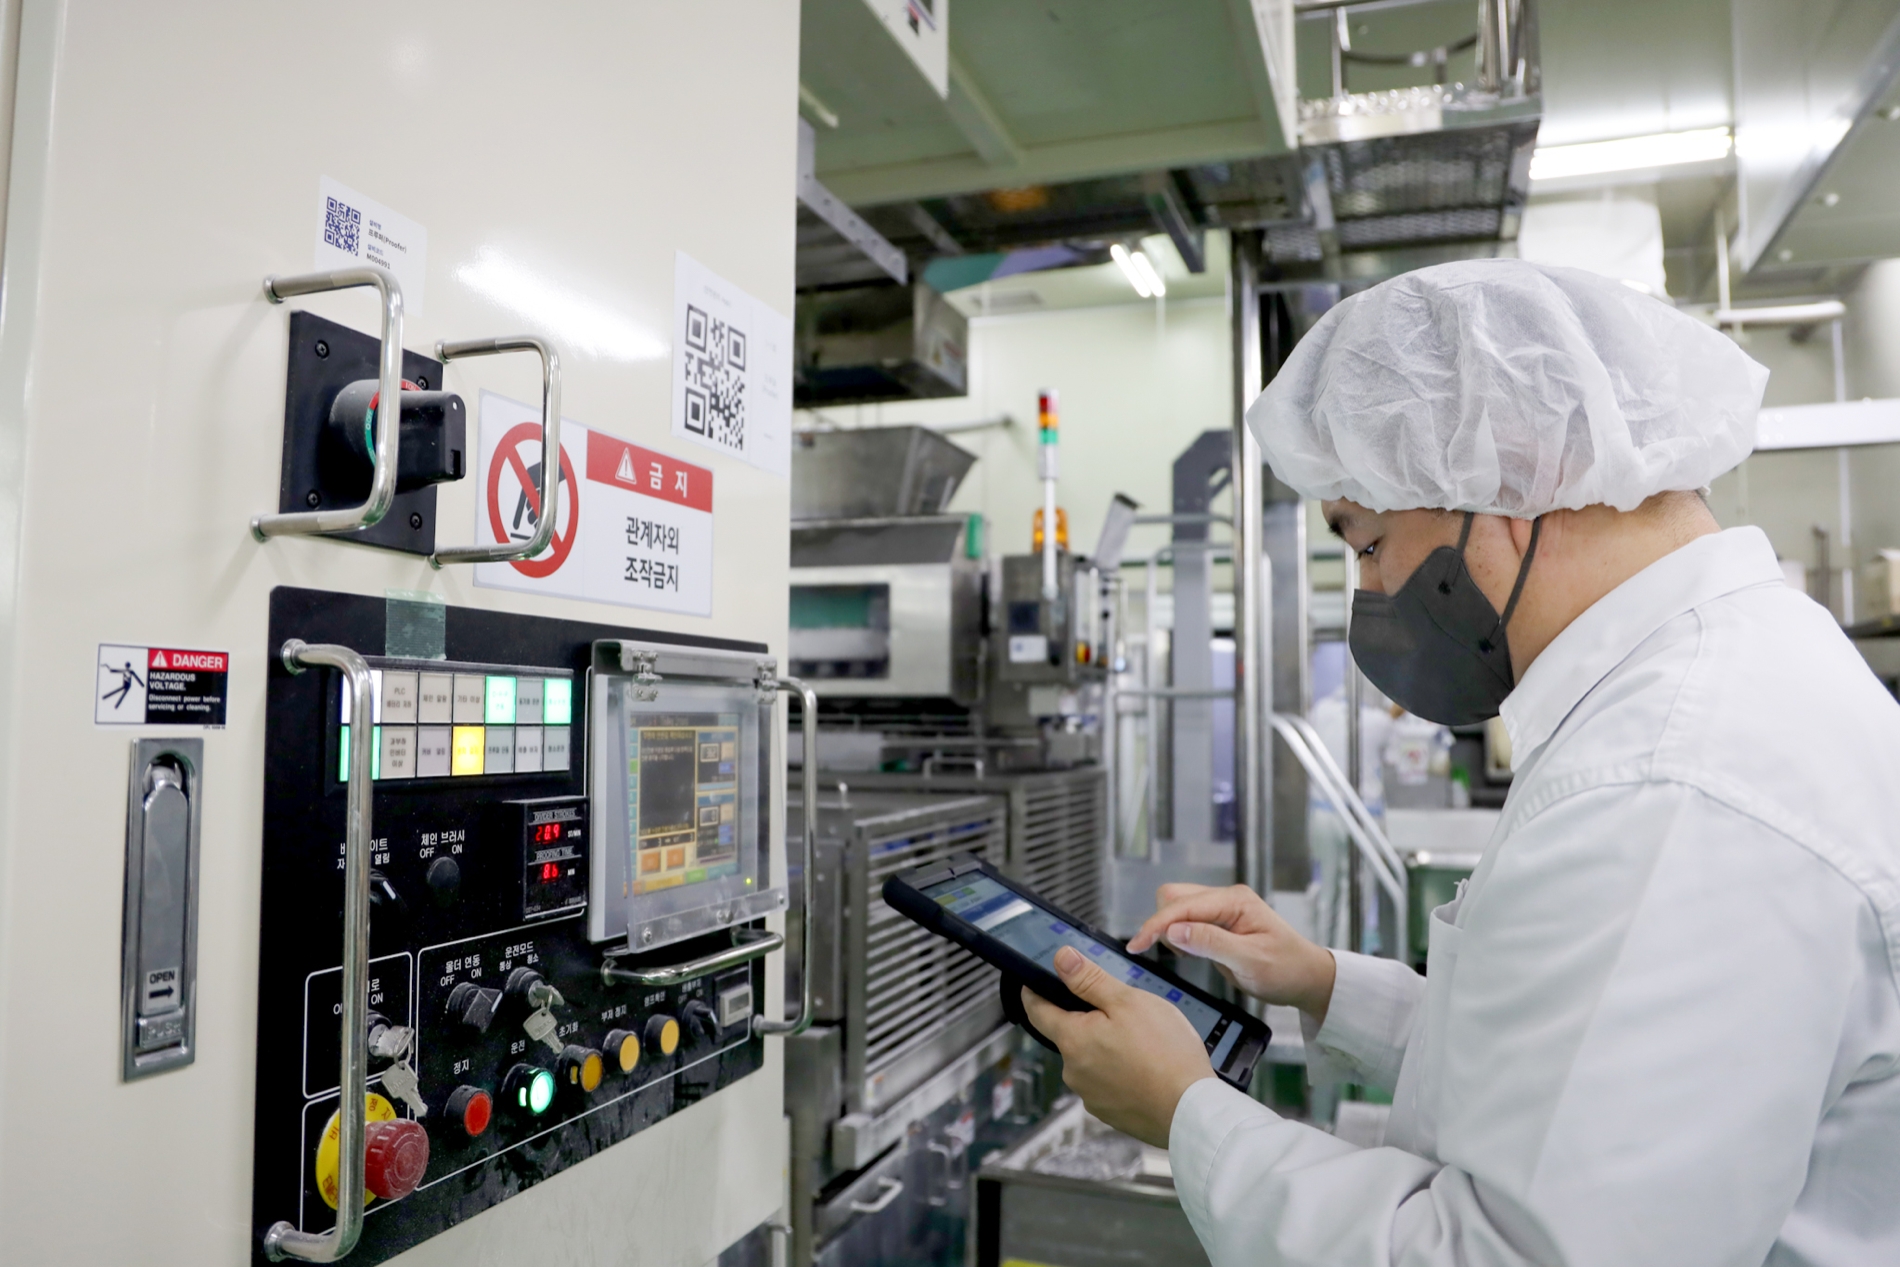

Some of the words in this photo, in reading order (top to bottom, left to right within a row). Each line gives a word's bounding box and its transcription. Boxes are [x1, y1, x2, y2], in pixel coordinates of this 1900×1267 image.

[366, 253, 391, 269] M004991
[625, 515, 680, 556] 관계자외
[624, 556, 680, 592] 조작금지
[172, 654, 223, 669] DANGER
[149, 672, 196, 682] HAZARDOUS
[149, 681, 187, 691] VOLTAGE.
[394, 687, 406, 695] PLC
[148, 694, 181, 703] Disconnect
[183, 696, 201, 704] power
[203, 695, 221, 703] before
[148, 703, 175, 712] servicing
[421, 833, 438, 846] 체인
[440, 829, 465, 844] 브러시
[419, 848, 435, 859] OFF
[451, 844, 463, 855] ON
[374, 853, 390, 866] 열림
[505, 941, 534, 959] 운전모드
[464, 954, 481, 969] 연동
[149, 970, 175, 984] OPEN
[440, 973, 455, 987] OFF
[470, 967, 482, 979] ON
[370, 992, 384, 1005] ON
[614, 1004, 627, 1018] 정지
[558, 1021, 579, 1037] 초기화
[510, 1039, 526, 1055] 운전
[453, 1059, 469, 1075] 정지
